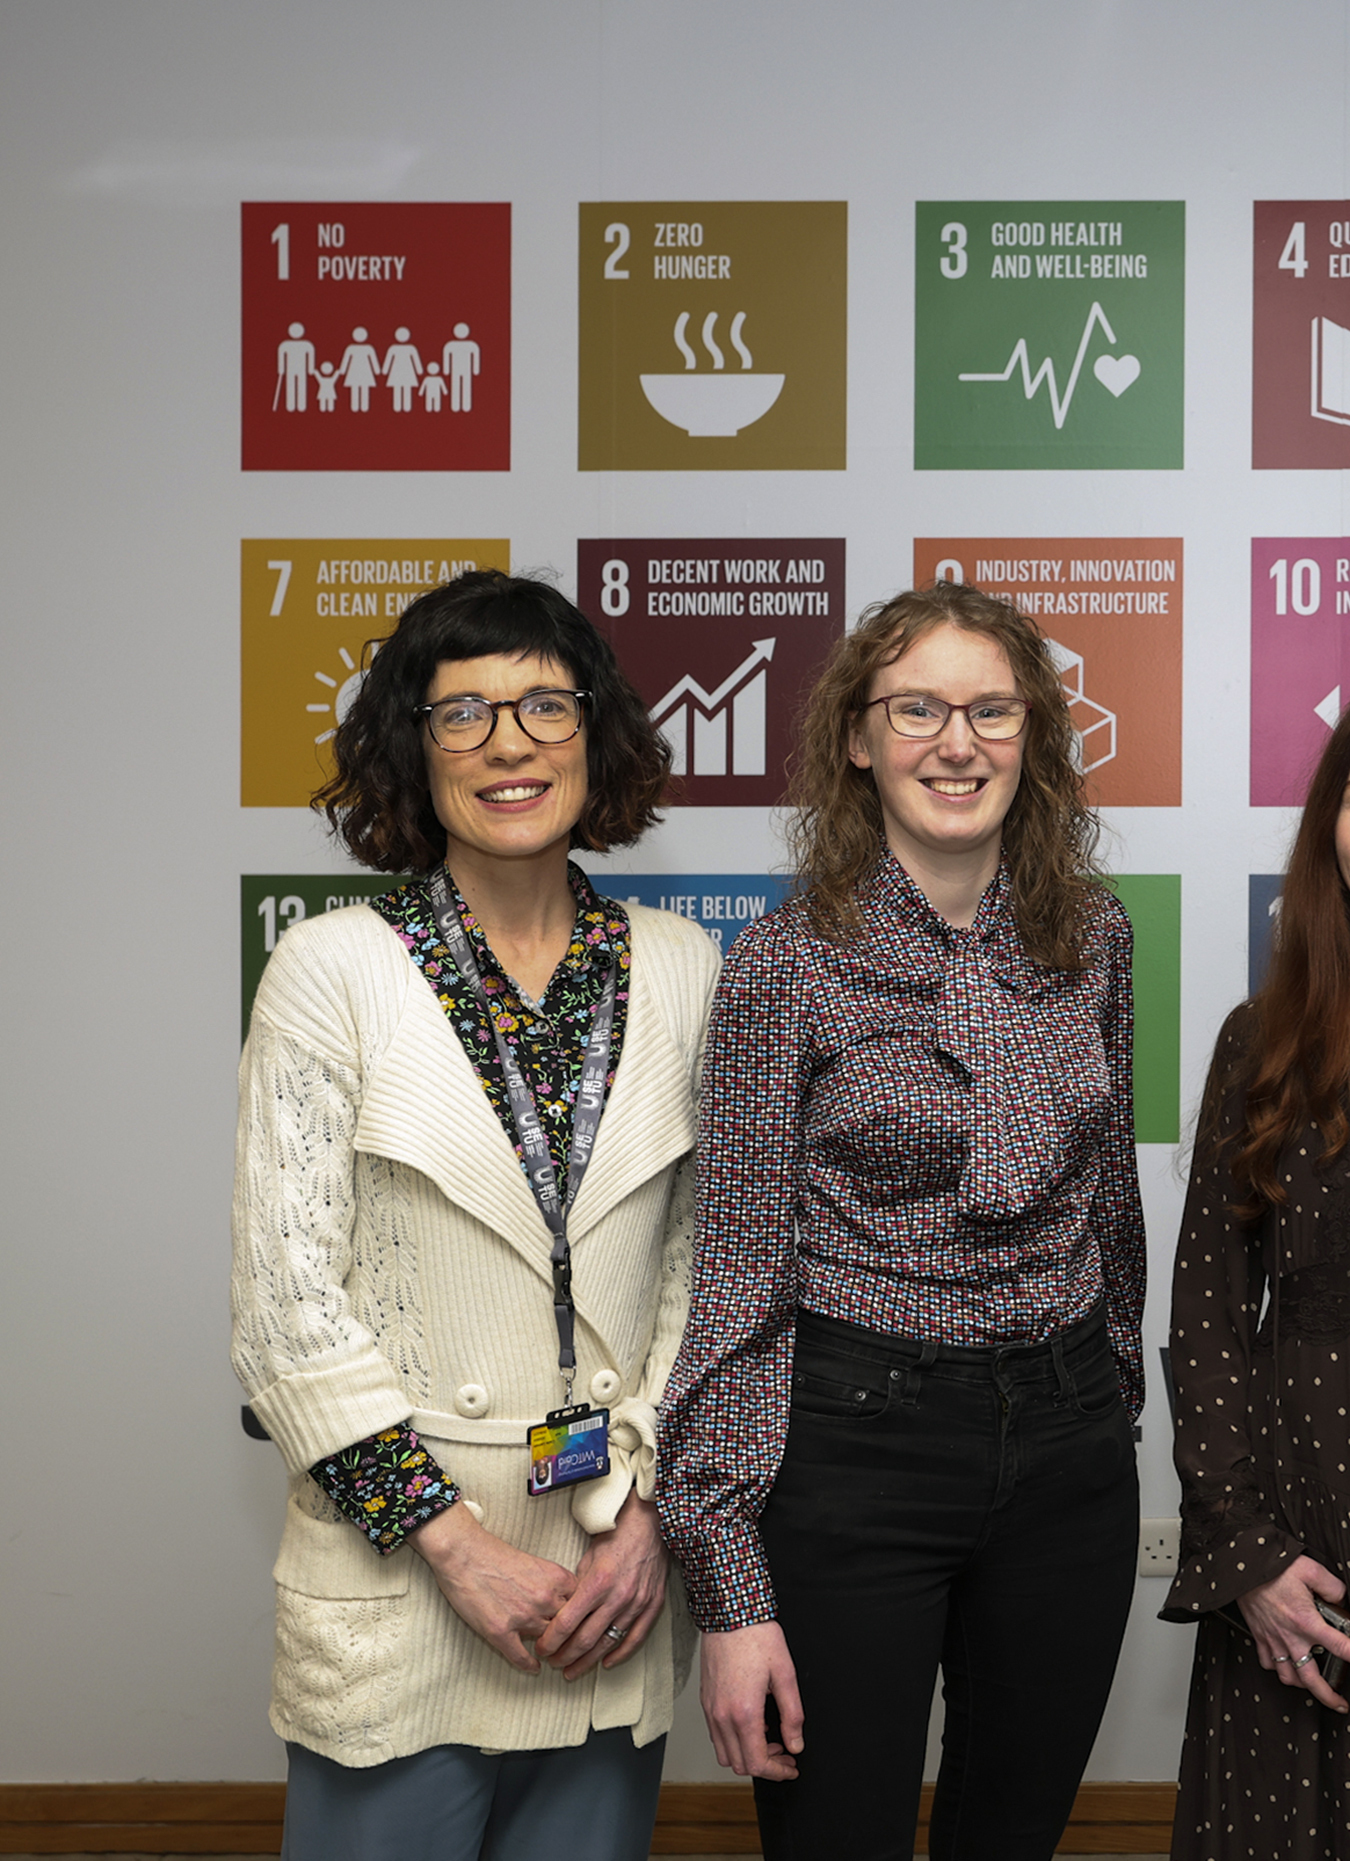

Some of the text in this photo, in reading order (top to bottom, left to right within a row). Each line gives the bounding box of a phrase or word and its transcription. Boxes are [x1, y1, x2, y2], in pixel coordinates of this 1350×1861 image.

[319, 224, 344, 247] NO
[655, 223, 703, 246] ZERO
[992, 223, 1121, 246] GOOD HEALTH
[272, 224, 289, 279] 1
[605, 223, 630, 279] 2
[941, 223, 967, 279] 3
[1279, 222, 1308, 277] 4
[319, 256, 405, 280] POVERTY
[655, 256, 730, 279] HUNGER
[992, 255, 1147, 278] AND WELL-BEING
[317, 561, 434, 584] AFFORDABLE
[649, 560, 824, 583] DECENT WORK AND
[976, 560, 1066, 583] INDUSTRY,
[1070, 560, 1175, 582] INNOVATION
[268, 561, 292, 616] 7
[602, 560, 629, 616] 8
[1270, 559, 1320, 615] 10
[317, 593, 377, 616] CLEAN
[648, 592, 828, 615] ECONOMIC GROWTH
[1016, 592, 1169, 614] INFRASTRUCTURE
[702, 896, 766, 919] BELOW
